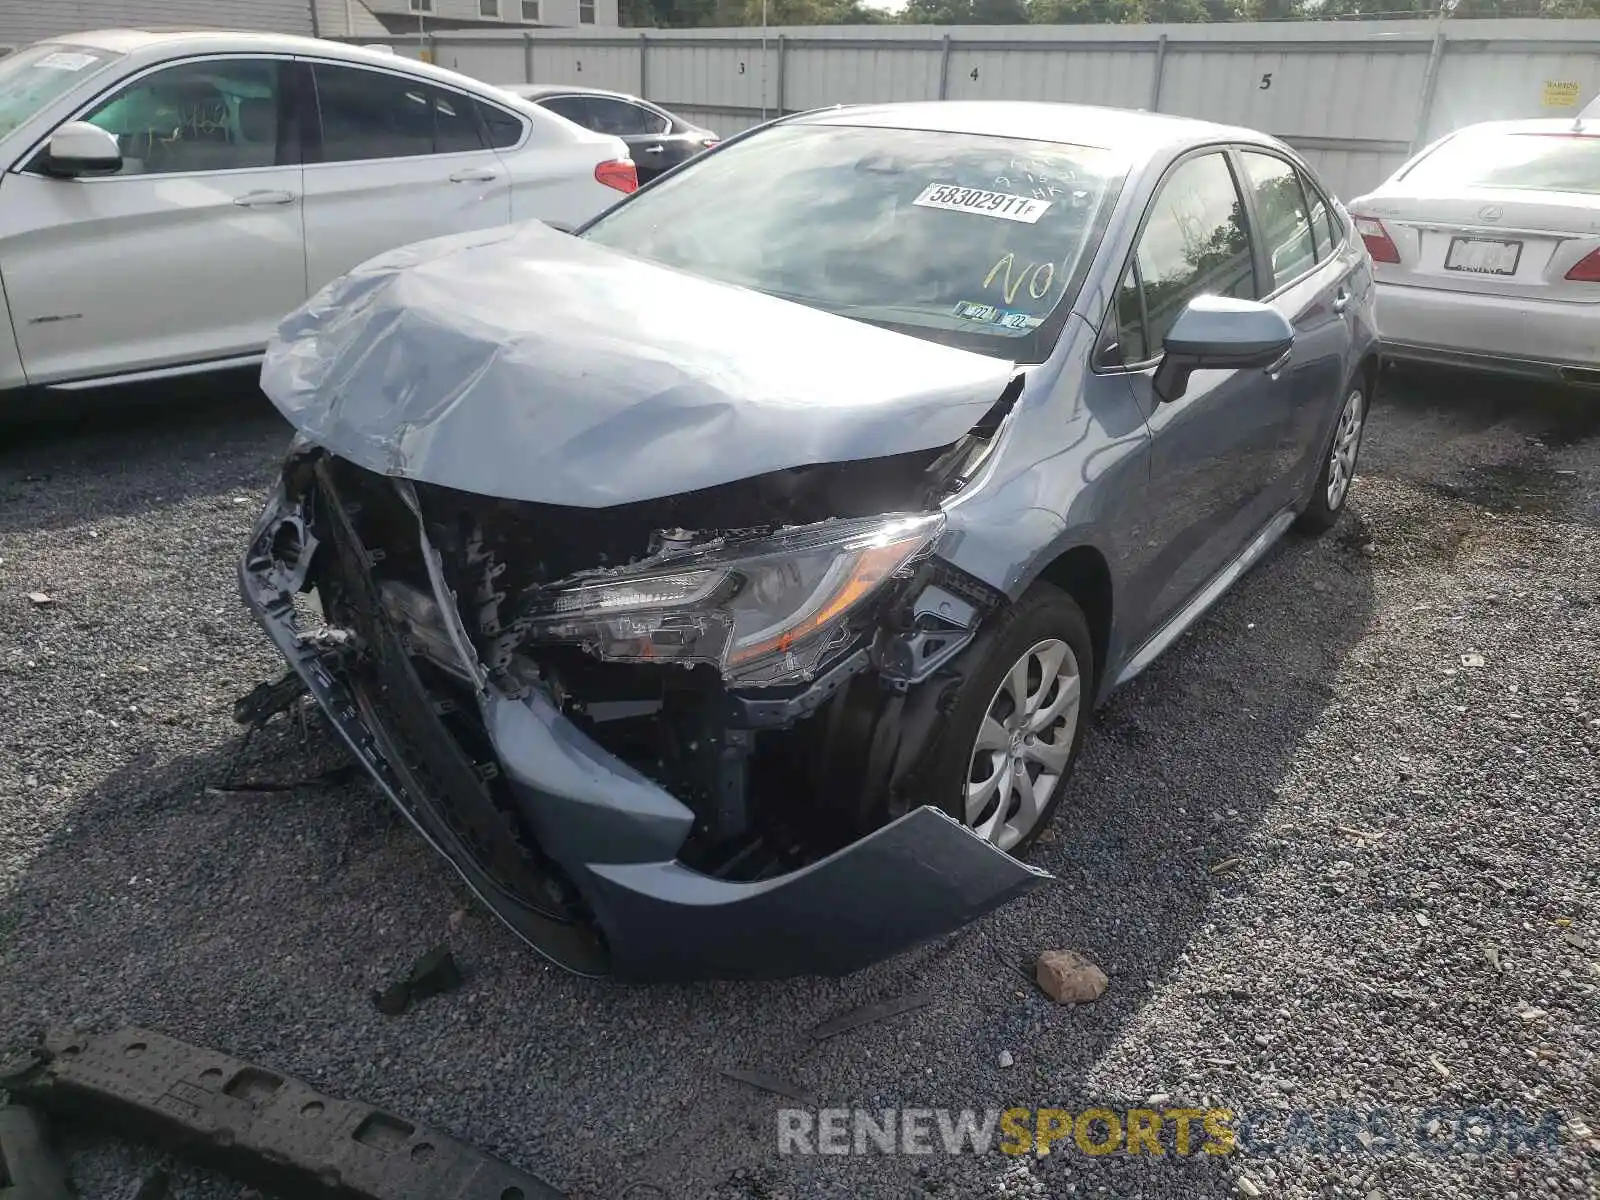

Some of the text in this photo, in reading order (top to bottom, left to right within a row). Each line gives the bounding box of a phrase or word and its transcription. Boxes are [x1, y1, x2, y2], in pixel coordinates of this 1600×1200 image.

[738, 62, 745, 75] 3
[970, 67, 979, 82] 4
[1259, 73, 1273, 90] 5
[983, 253, 1054, 304] NO
[1011, 314, 1026, 328] 22
